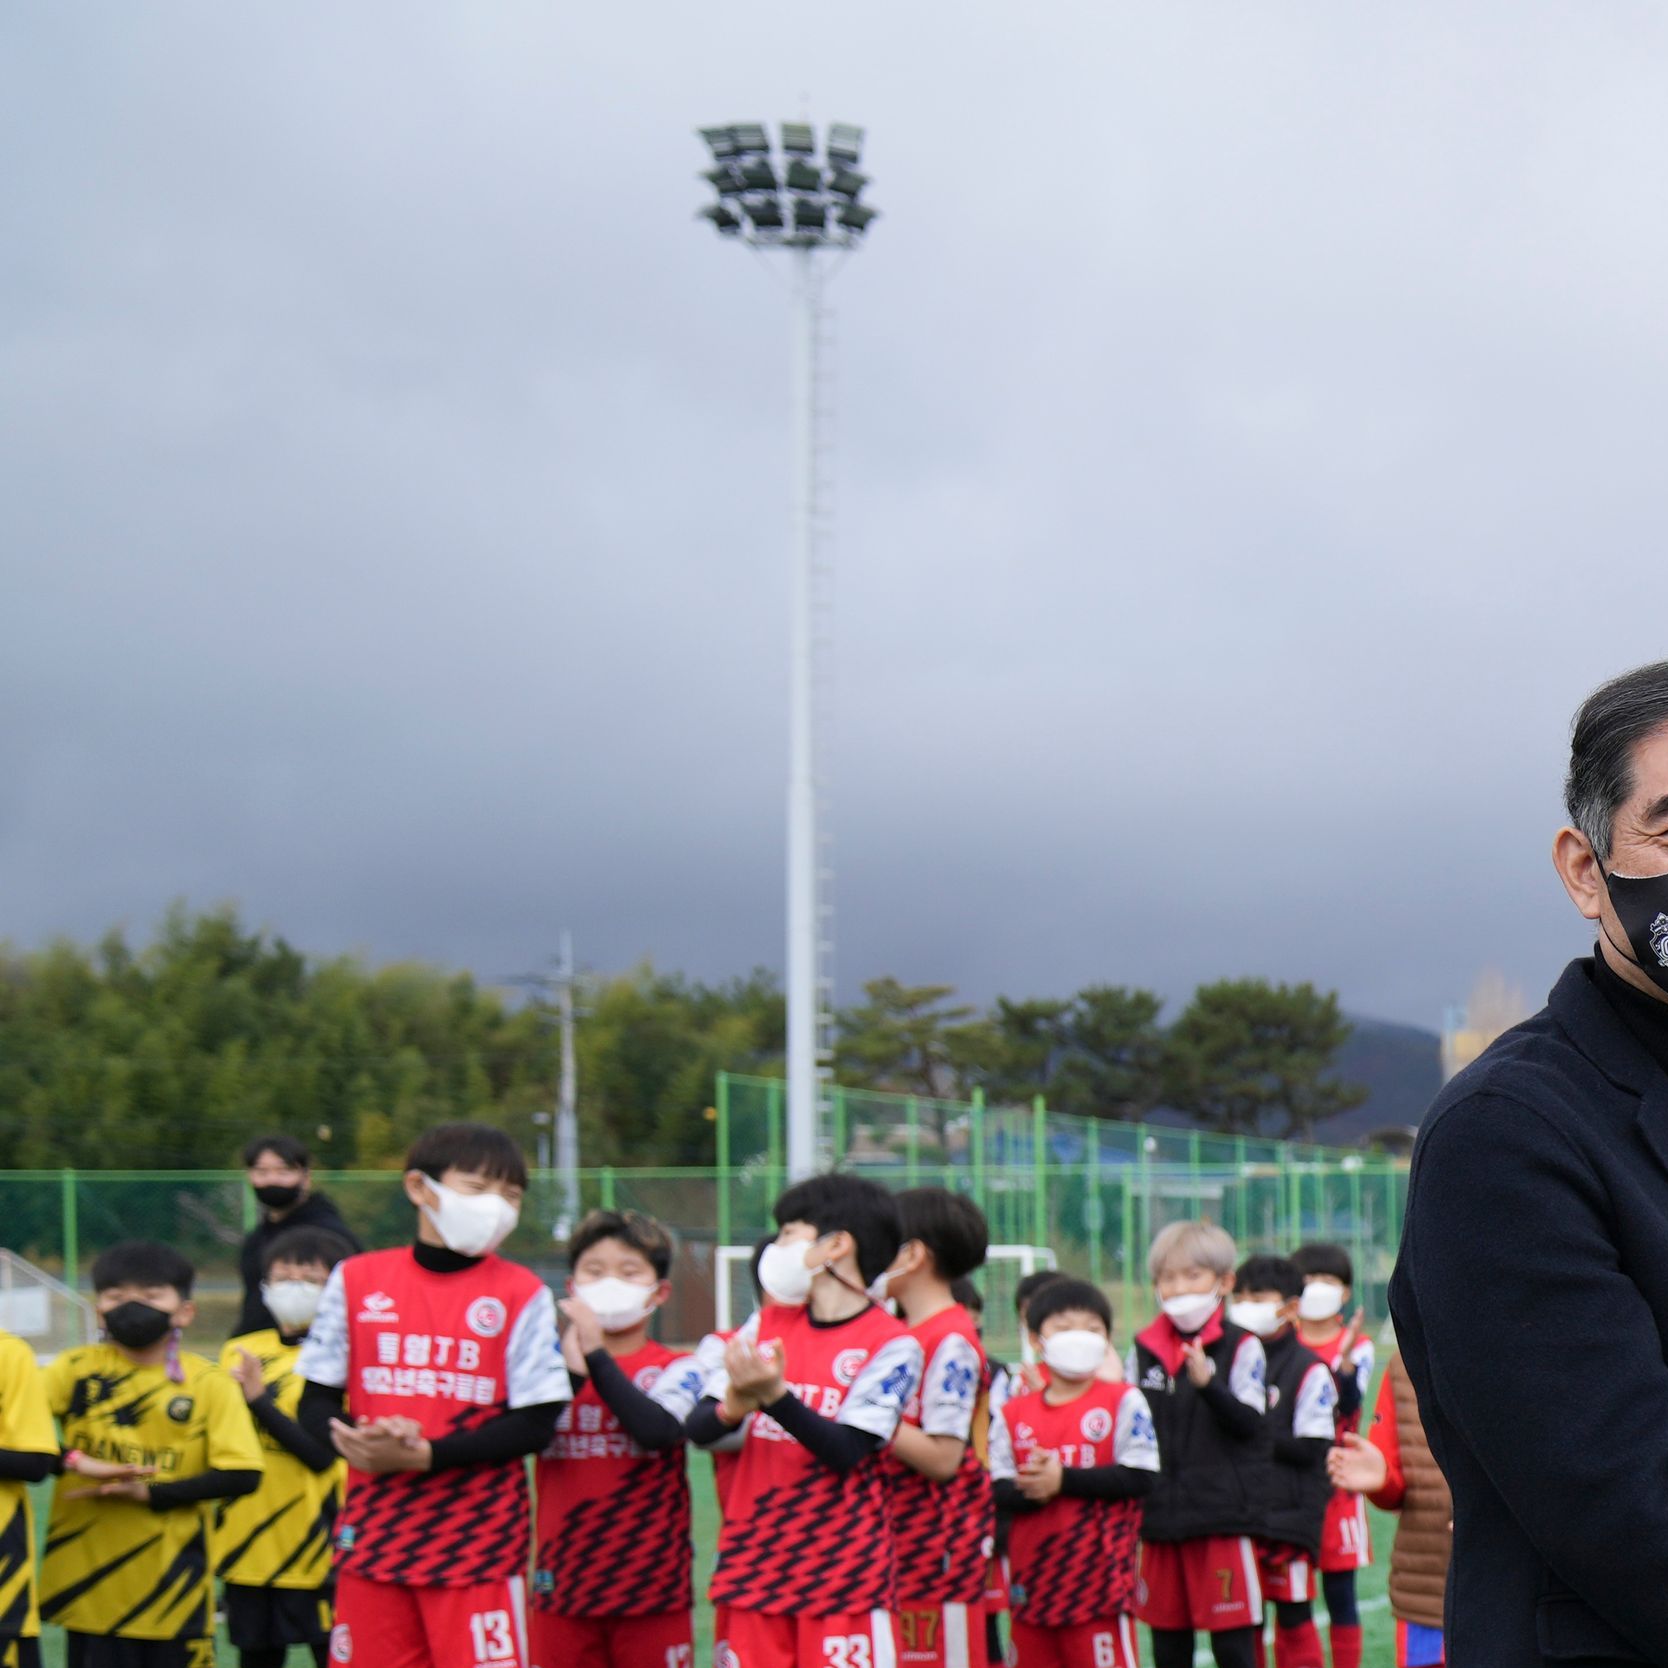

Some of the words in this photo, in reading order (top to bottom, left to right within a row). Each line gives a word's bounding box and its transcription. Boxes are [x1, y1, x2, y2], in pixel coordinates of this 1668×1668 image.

[1216, 1569, 1233, 1601] 7
[471, 1609, 514, 1662] 13
[1093, 1632, 1115, 1668] 6
